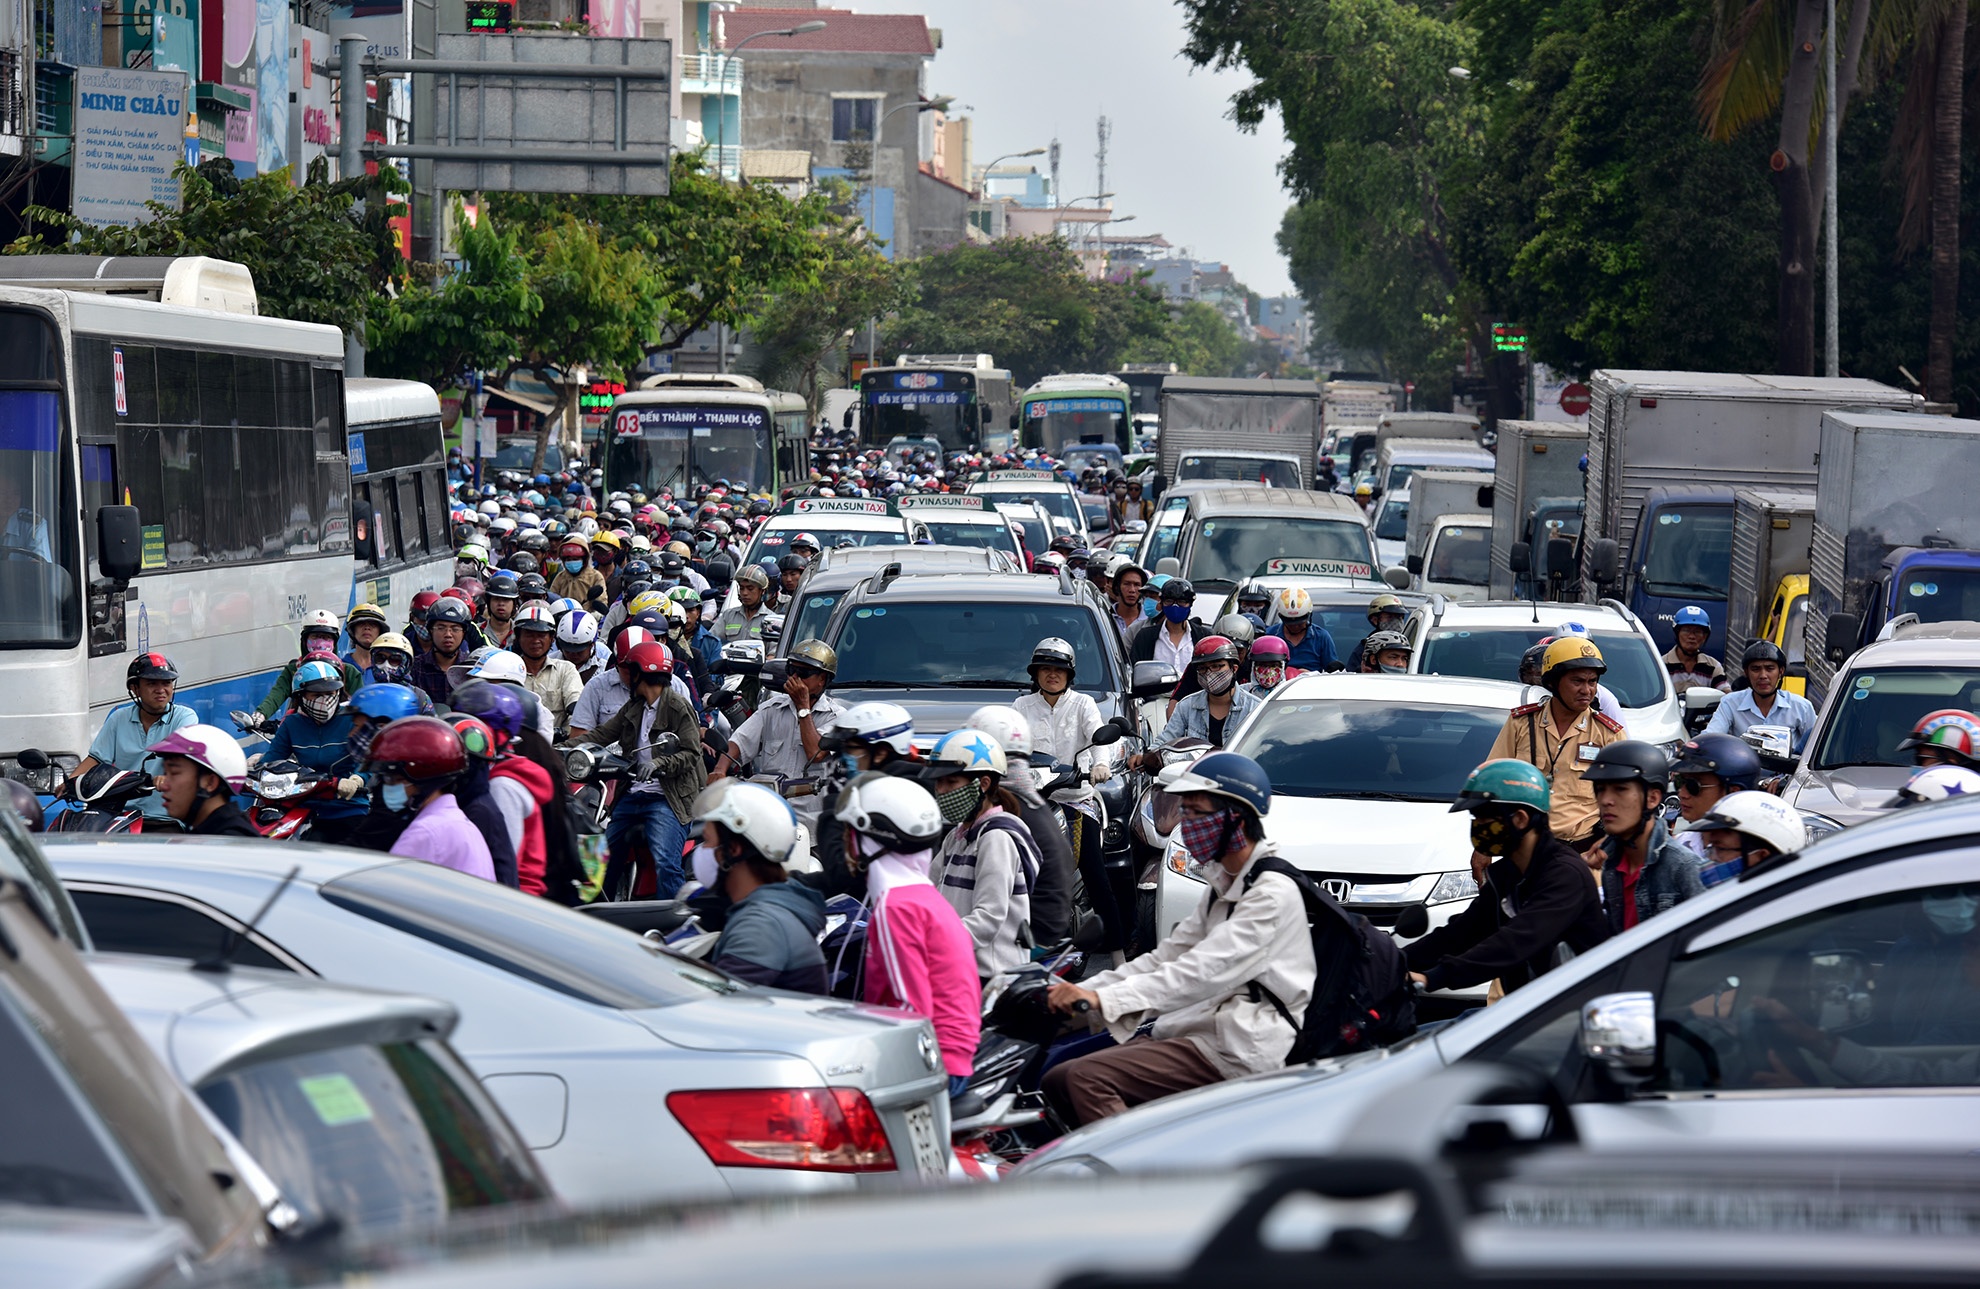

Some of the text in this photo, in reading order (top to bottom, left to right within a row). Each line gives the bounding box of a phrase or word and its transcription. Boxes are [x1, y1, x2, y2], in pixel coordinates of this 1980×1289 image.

[81, 92, 180, 116] MINH CHÂU
[141, 166, 165, 174] STRESS
[1032, 403, 1046, 416] 59
[617, 415, 639, 434] 03
[640, 411, 762, 426] BẾN THÀNH THẠNH LỘC
[1004, 471, 1053, 480] VINASUN TAXI
[818, 502, 886, 513] VINASUN TAXI
[919, 497, 981, 507] VINASUN TAXI
[1292, 563, 1371, 576] VINASUN TAXI
